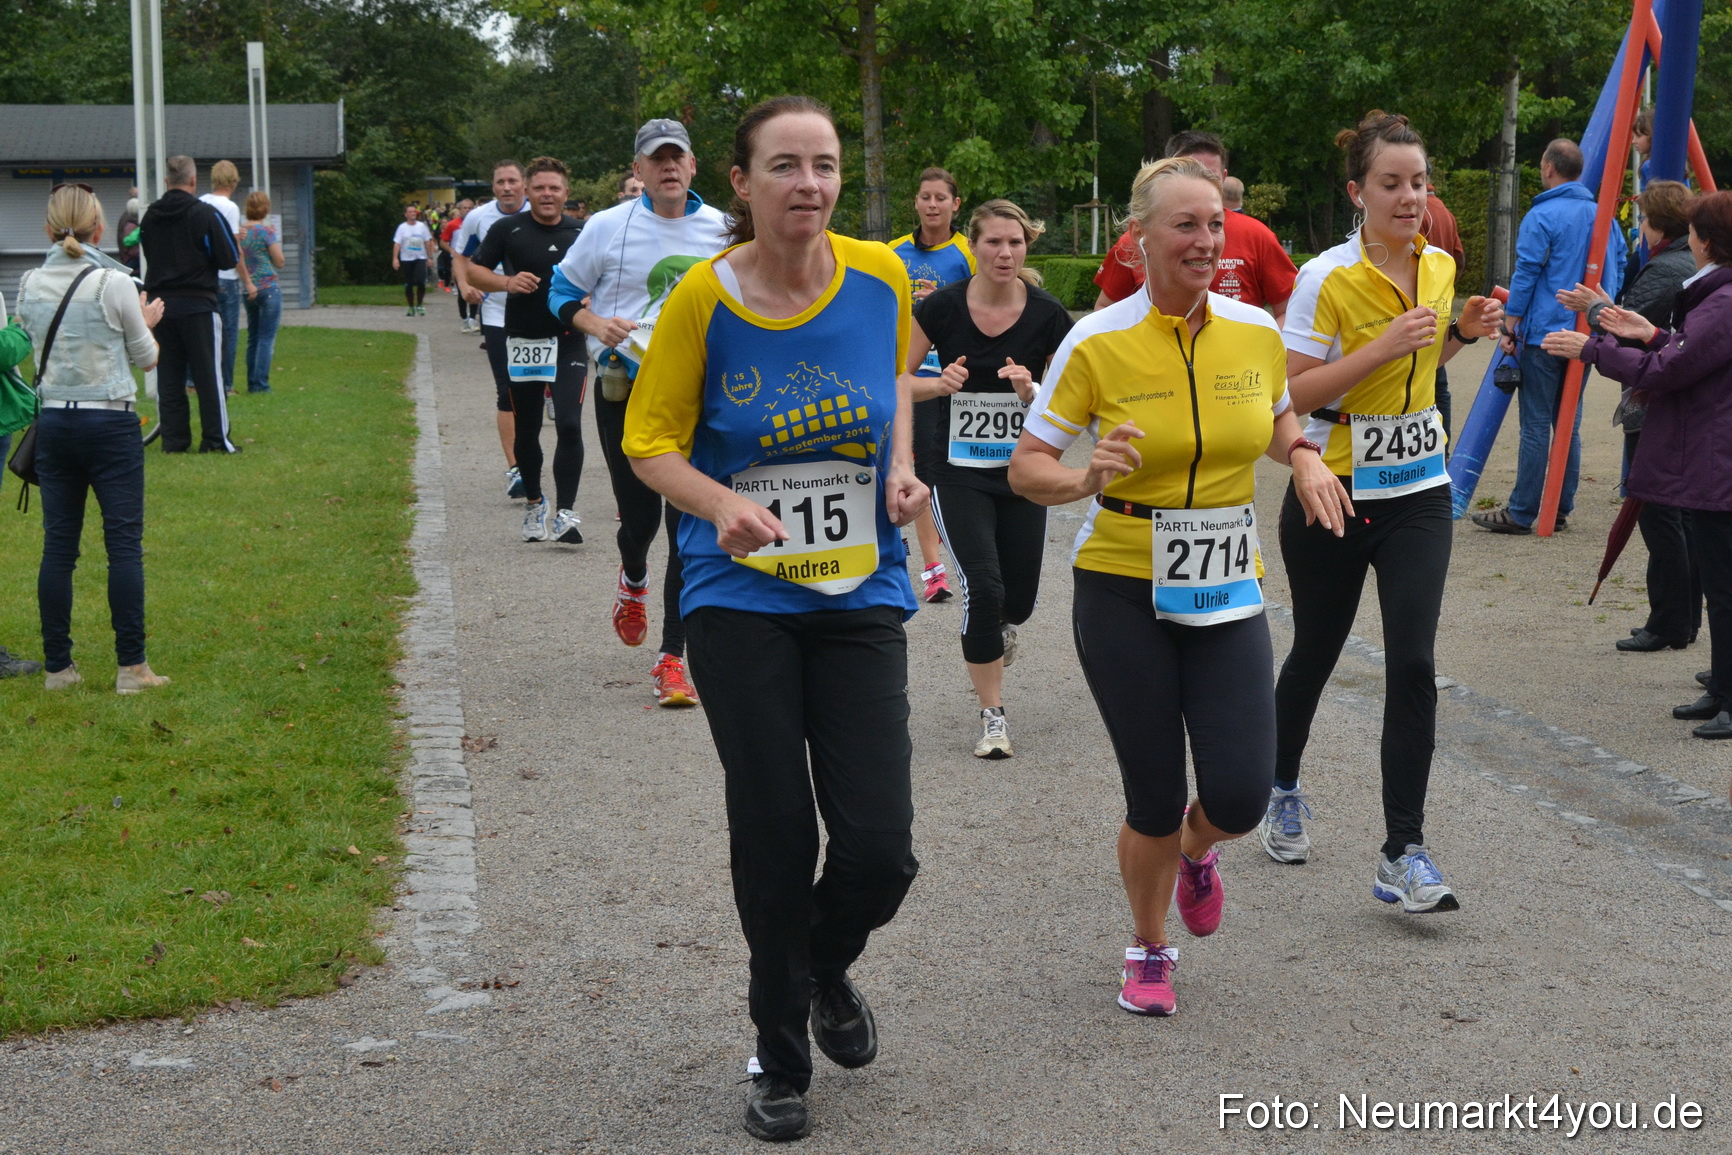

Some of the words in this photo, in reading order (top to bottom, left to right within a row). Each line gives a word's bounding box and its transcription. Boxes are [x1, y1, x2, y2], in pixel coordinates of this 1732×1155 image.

[512, 346, 552, 364] 2387
[734, 372, 745, 381] 15
[730, 382, 754, 393] Jahre
[953, 400, 978, 408] PARTL
[958, 410, 1024, 440] 2299
[782, 434, 842, 452] September
[845, 426, 870, 438] 2014
[1364, 418, 1438, 462] 2435
[970, 446, 1012, 458] Melanie
[735, 480, 779, 494] PARTL
[782, 474, 850, 490] Neumarkt
[1378, 466, 1426, 485] Stefanie
[766, 492, 849, 548] 115
[1156, 522, 1198, 532] PARTL
[1200, 518, 1244, 532] Neumarkt
[1167, 533, 1249, 580] 2714
[775, 560, 841, 580] Andrea
[1194, 590, 1230, 610] Ulrike
